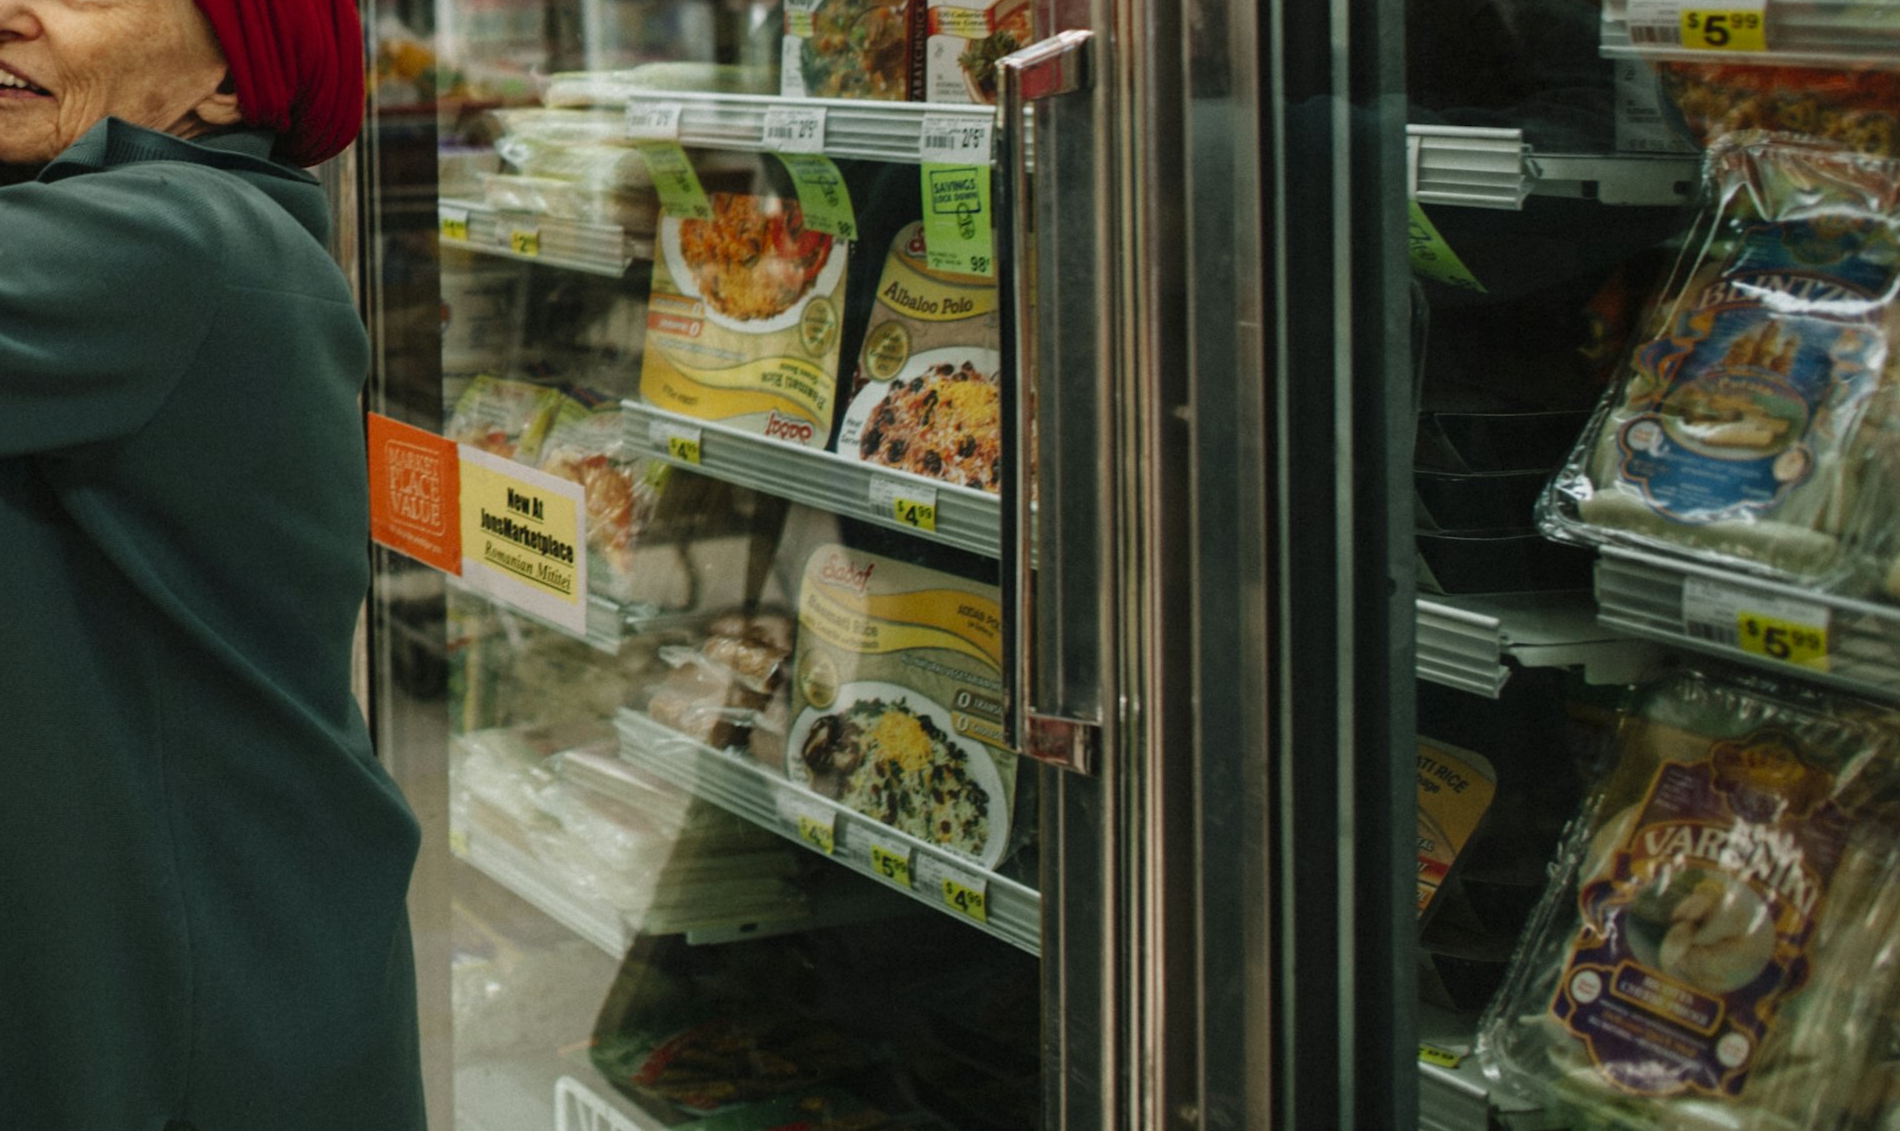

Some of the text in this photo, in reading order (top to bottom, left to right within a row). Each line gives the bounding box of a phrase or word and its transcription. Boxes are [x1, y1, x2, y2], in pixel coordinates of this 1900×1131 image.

[933, 178, 977, 195] SAVINGS
[883, 280, 974, 315] Albaloo Polo
[387, 446, 440, 478] MARKET
[390, 465, 440, 502] PLACE
[391, 490, 441, 526] VALUE
[507, 487, 544, 520] New At
[480, 507, 574, 564] JonsMarketplace
[484, 541, 571, 590] Romanian Mititei
[822, 554, 875, 595] Sadaf
[1438, 765, 1469, 794] RICE
